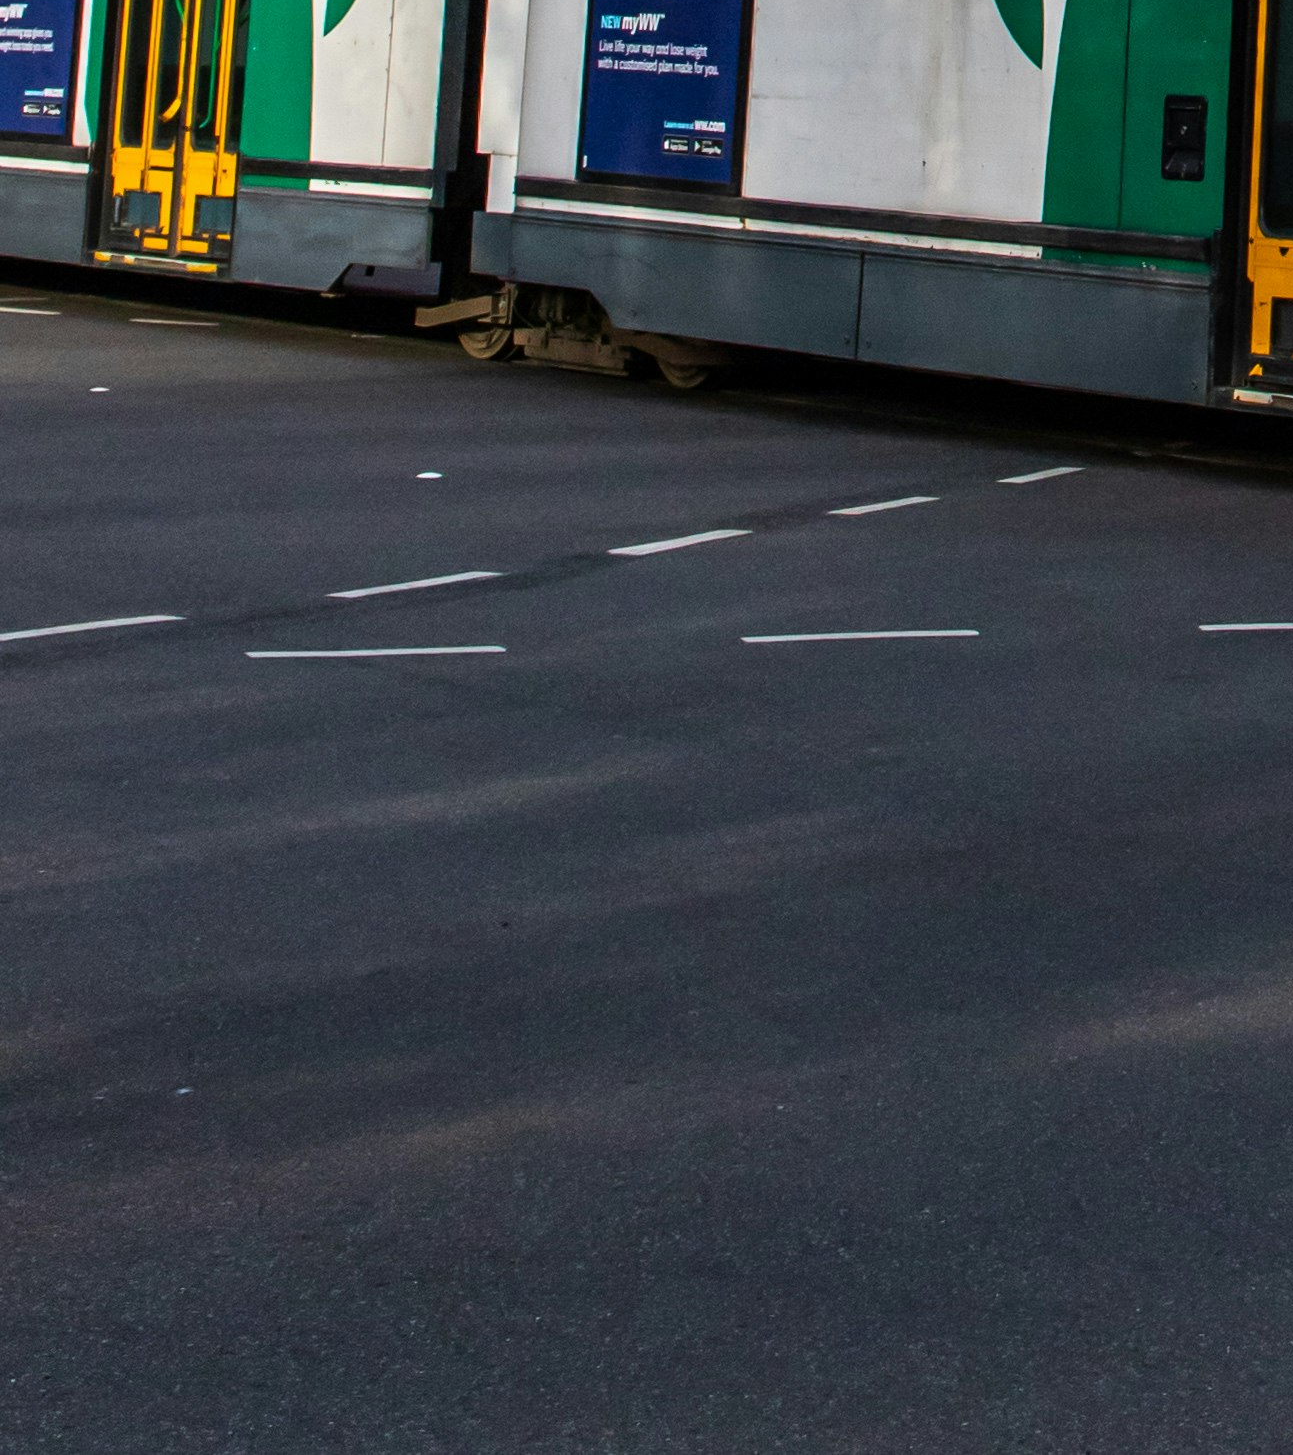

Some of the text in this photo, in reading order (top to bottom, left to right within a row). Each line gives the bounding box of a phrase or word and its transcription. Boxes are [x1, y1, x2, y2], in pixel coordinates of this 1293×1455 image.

[601, 15, 621, 29] NEW
[625, 43, 641, 55] your
[641, 44, 655, 57] way
